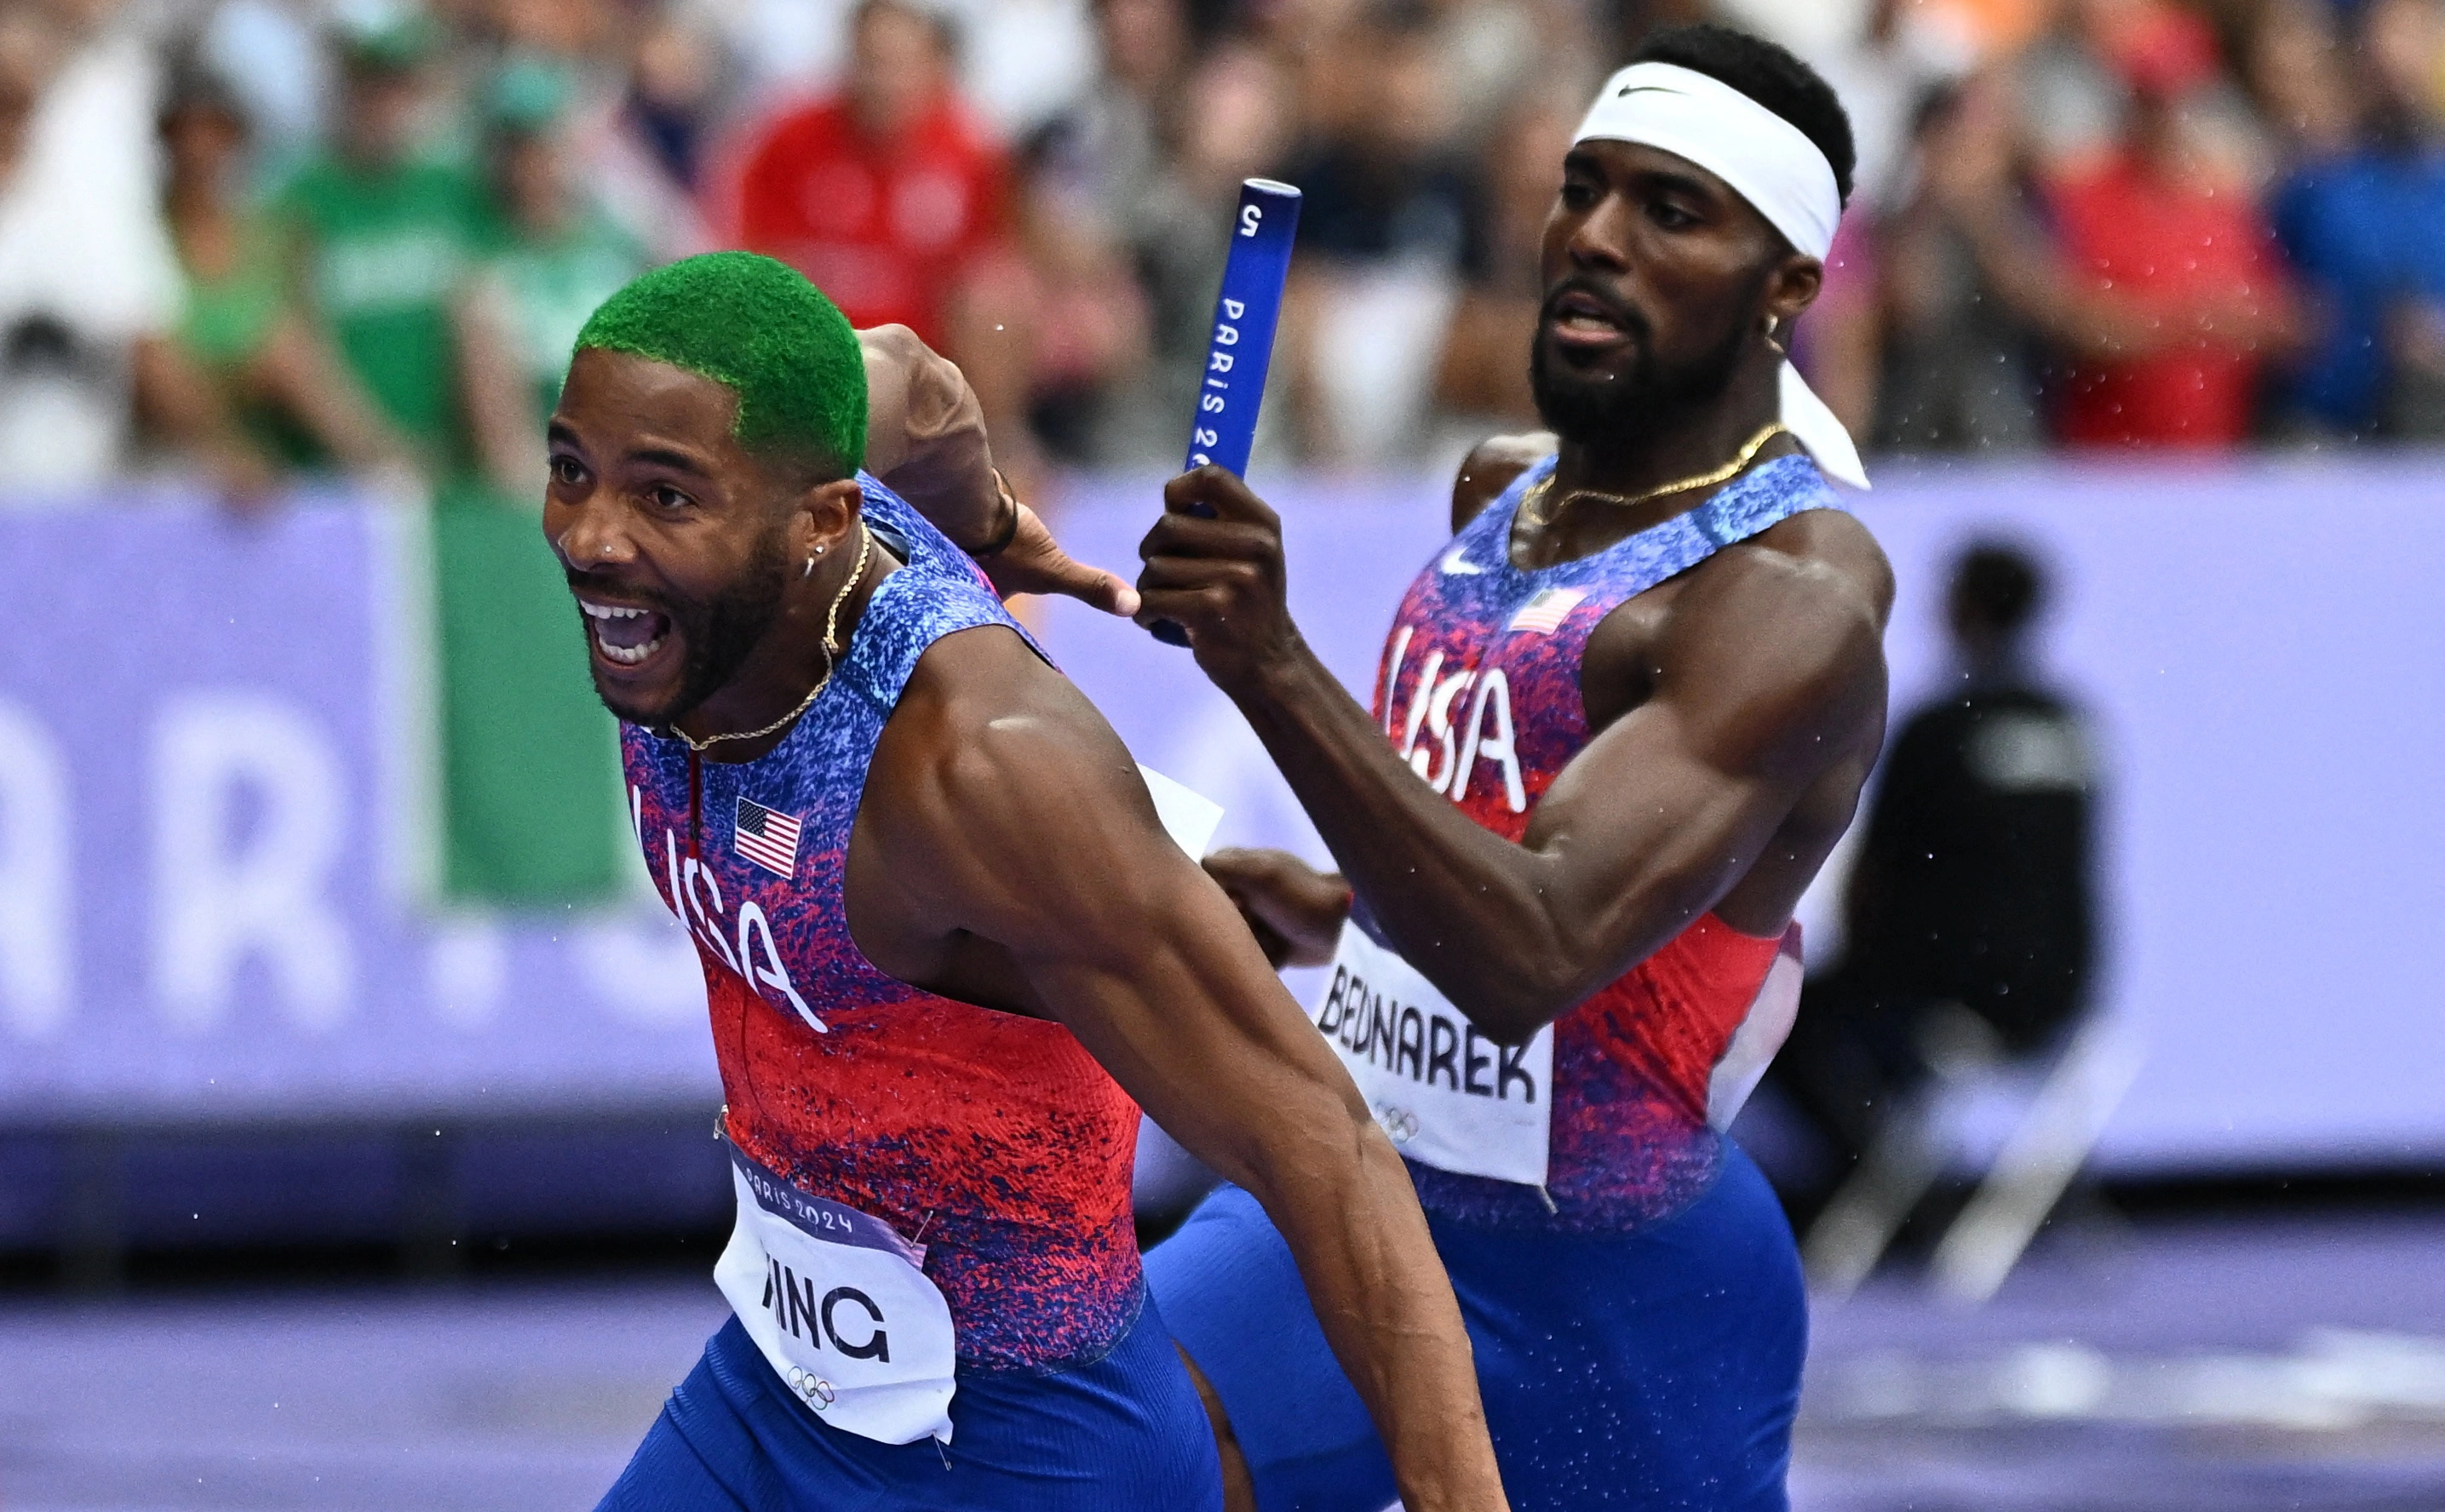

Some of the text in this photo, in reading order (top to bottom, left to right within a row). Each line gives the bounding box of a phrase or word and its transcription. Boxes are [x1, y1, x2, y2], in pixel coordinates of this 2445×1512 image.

[1240, 203, 1262, 238] 5
[1385, 625, 1527, 813] USA
[1317, 963, 1535, 1104] BEDNAREK
[795, 1199, 852, 1234] 2024
